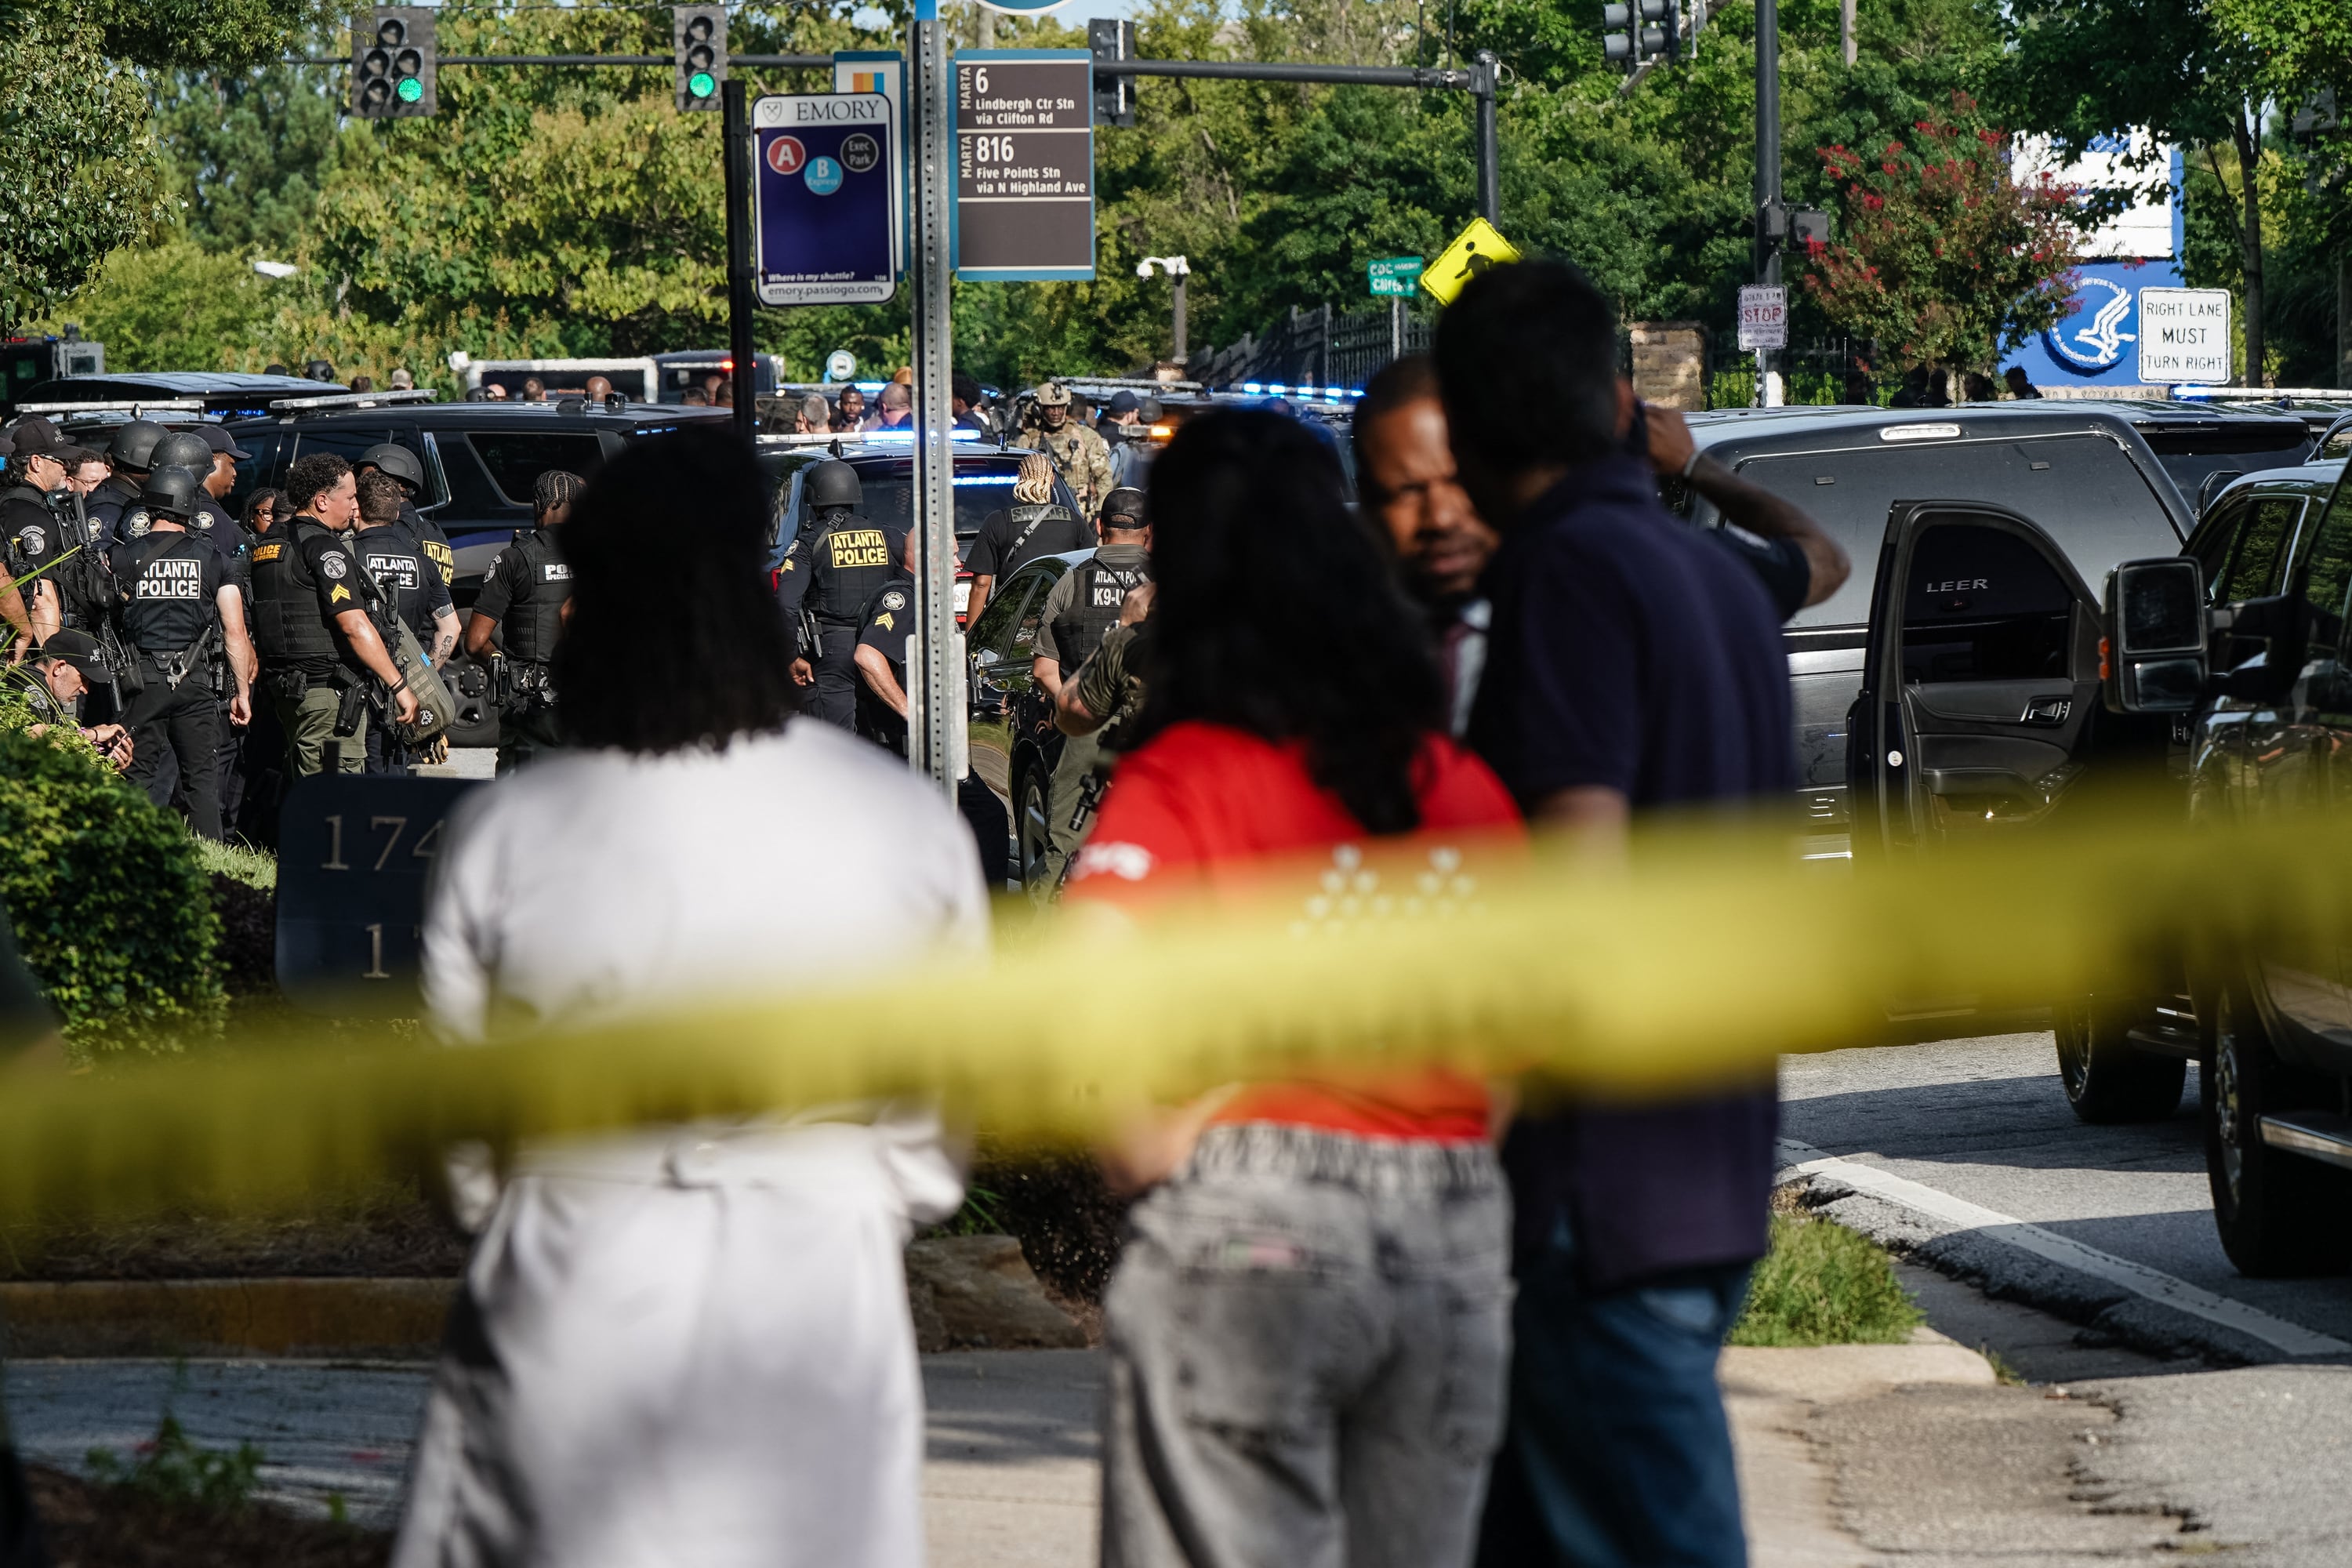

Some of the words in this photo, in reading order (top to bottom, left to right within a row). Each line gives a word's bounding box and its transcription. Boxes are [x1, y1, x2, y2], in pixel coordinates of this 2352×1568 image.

[975, 67, 989, 94] 6
[960, 67, 971, 110] MARTA
[796, 100, 879, 122] EMORY
[975, 98, 1033, 112] Lindbergh
[1036, 98, 1053, 110] Ctr
[1056, 98, 1075, 110] Stn
[975, 112, 993, 125] via
[996, 112, 1035, 125] Clifton
[1039, 112, 1054, 125] Rd
[848, 140, 870, 152] Exec
[976, 136, 1014, 163] 816
[776, 143, 796, 166] A
[849, 154, 871, 166] Park
[960, 136, 972, 179] MARTA
[816, 158, 829, 178] B
[976, 167, 1000, 179] Five
[1004, 166, 1039, 179] Points
[1042, 167, 1061, 179] Stn
[976, 182, 994, 194] via
[998, 182, 1007, 194] N
[1011, 181, 1061, 196] Highland
[1065, 182, 1087, 194] Ave
[768, 273, 796, 283] Where
[797, 272, 804, 282] is
[805, 273, 819, 282] my
[820, 271, 855, 281] shuttle?
[768, 285, 880, 297] emory.passiogo.com
[1744, 307, 1782, 323] STOP
[2147, 303, 2183, 316] RIGHT
[2189, 303, 2222, 317] LANE
[2162, 327, 2207, 344] MUST
[2146, 355, 2180, 368] TURN
[2186, 357, 2223, 370] RIGHT
[833, 532, 884, 549] ATLANTA
[834, 548, 886, 565] POLICE
[369, 557, 416, 572] ATLANTA
[375, 572, 412, 586] PCE
[1926, 579, 1989, 593] LEER
[139, 579, 198, 597] POLICE
[1094, 588, 1126, 606] K9-U
